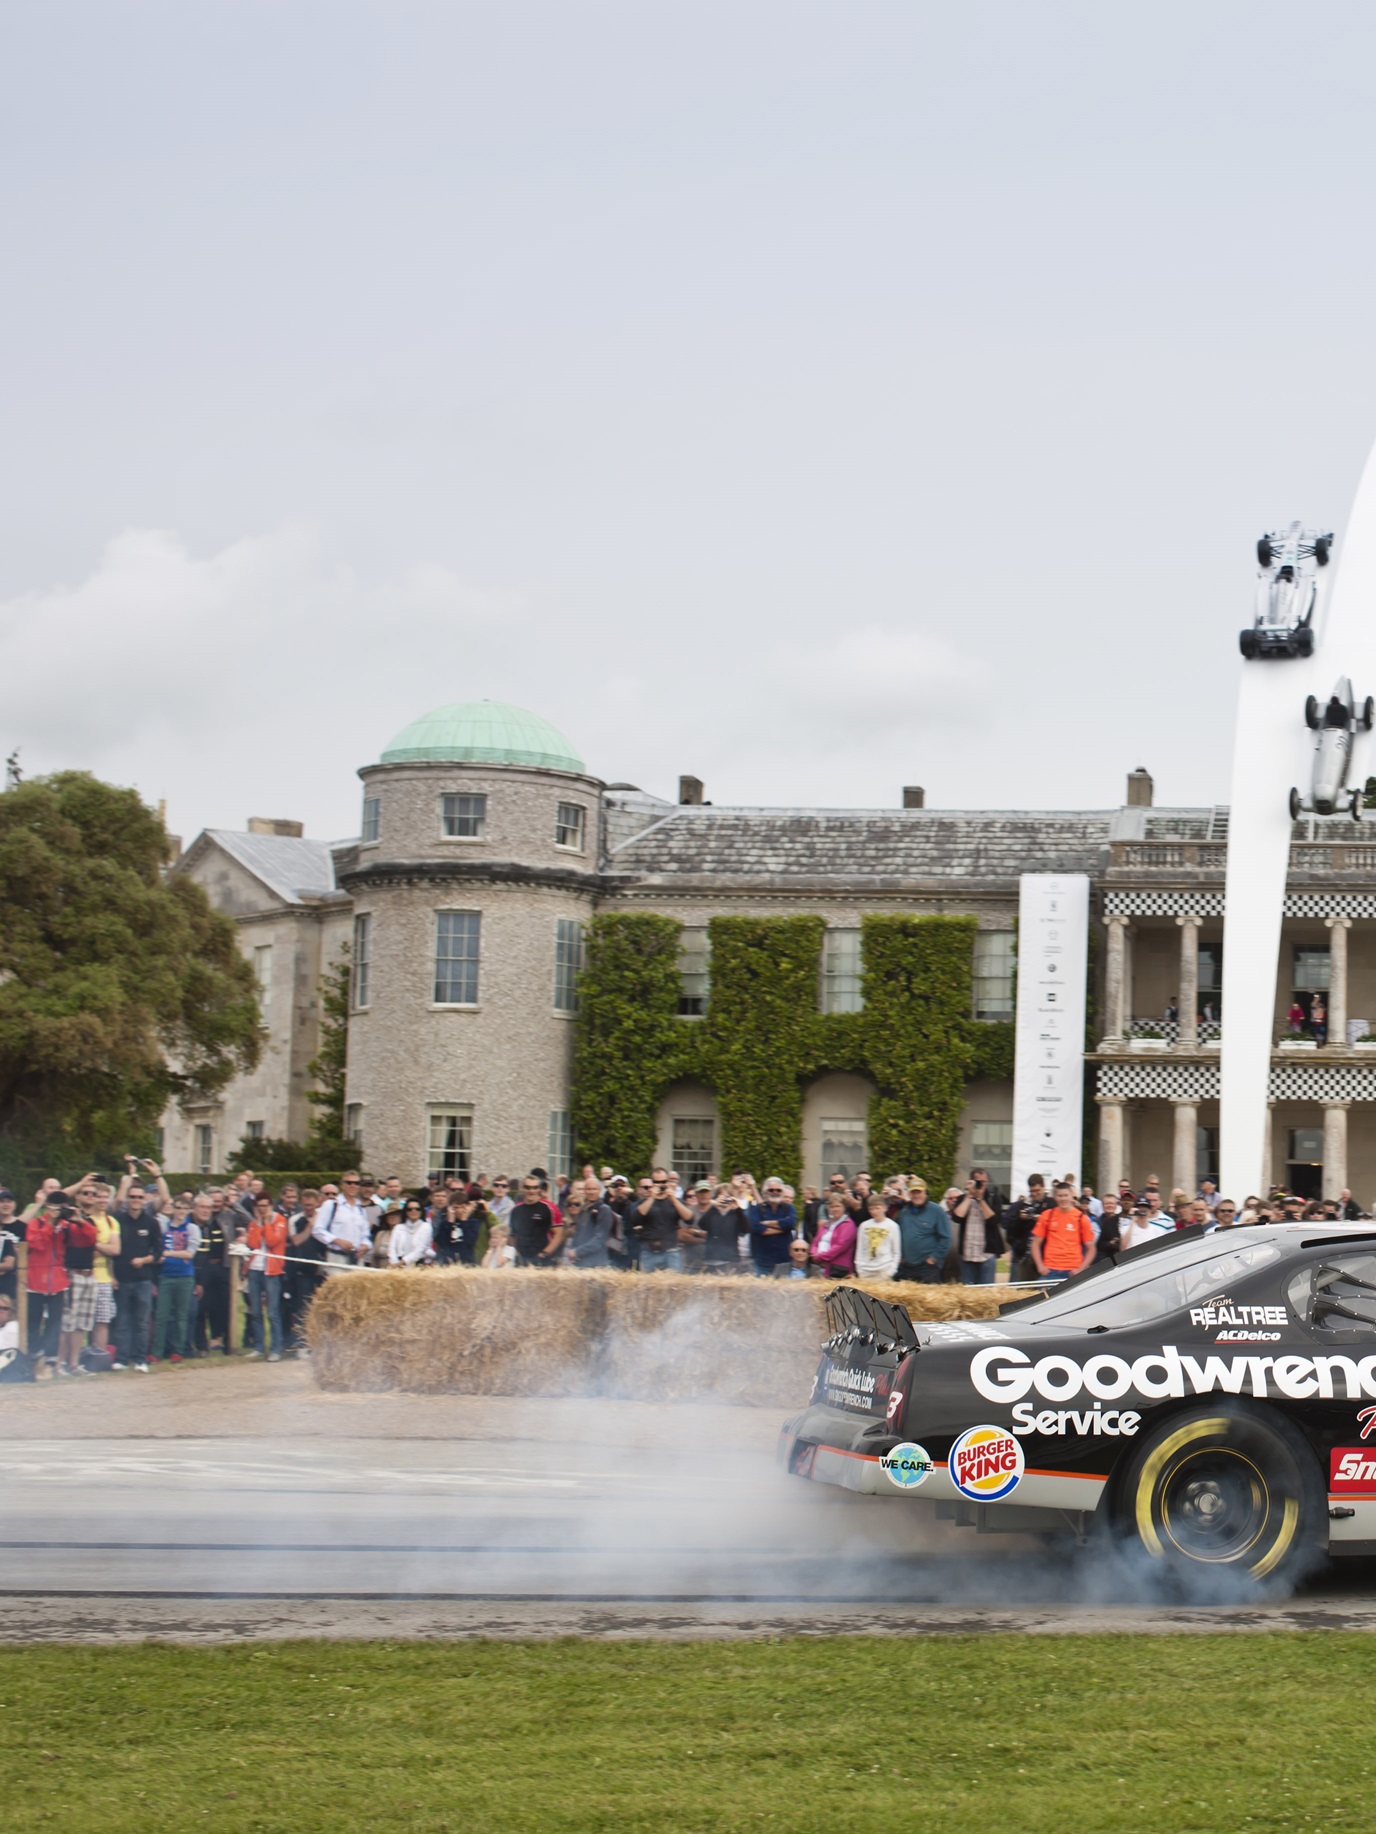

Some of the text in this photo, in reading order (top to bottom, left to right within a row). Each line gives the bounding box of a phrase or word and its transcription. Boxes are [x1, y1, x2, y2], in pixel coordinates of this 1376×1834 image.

[1201, 1294, 1235, 1310] Team
[1189, 1306, 1289, 1326] REALTREE
[1215, 1330, 1282, 1341] ACDelco
[860, 1371, 876, 1394] Lube
[886, 1391, 904, 1419] 3
[1012, 1402, 1142, 1436] Service
[957, 1438, 1015, 1467] BURGER
[881, 1458, 934, 1472] WE CARE.
[959, 1451, 1017, 1486] KING
